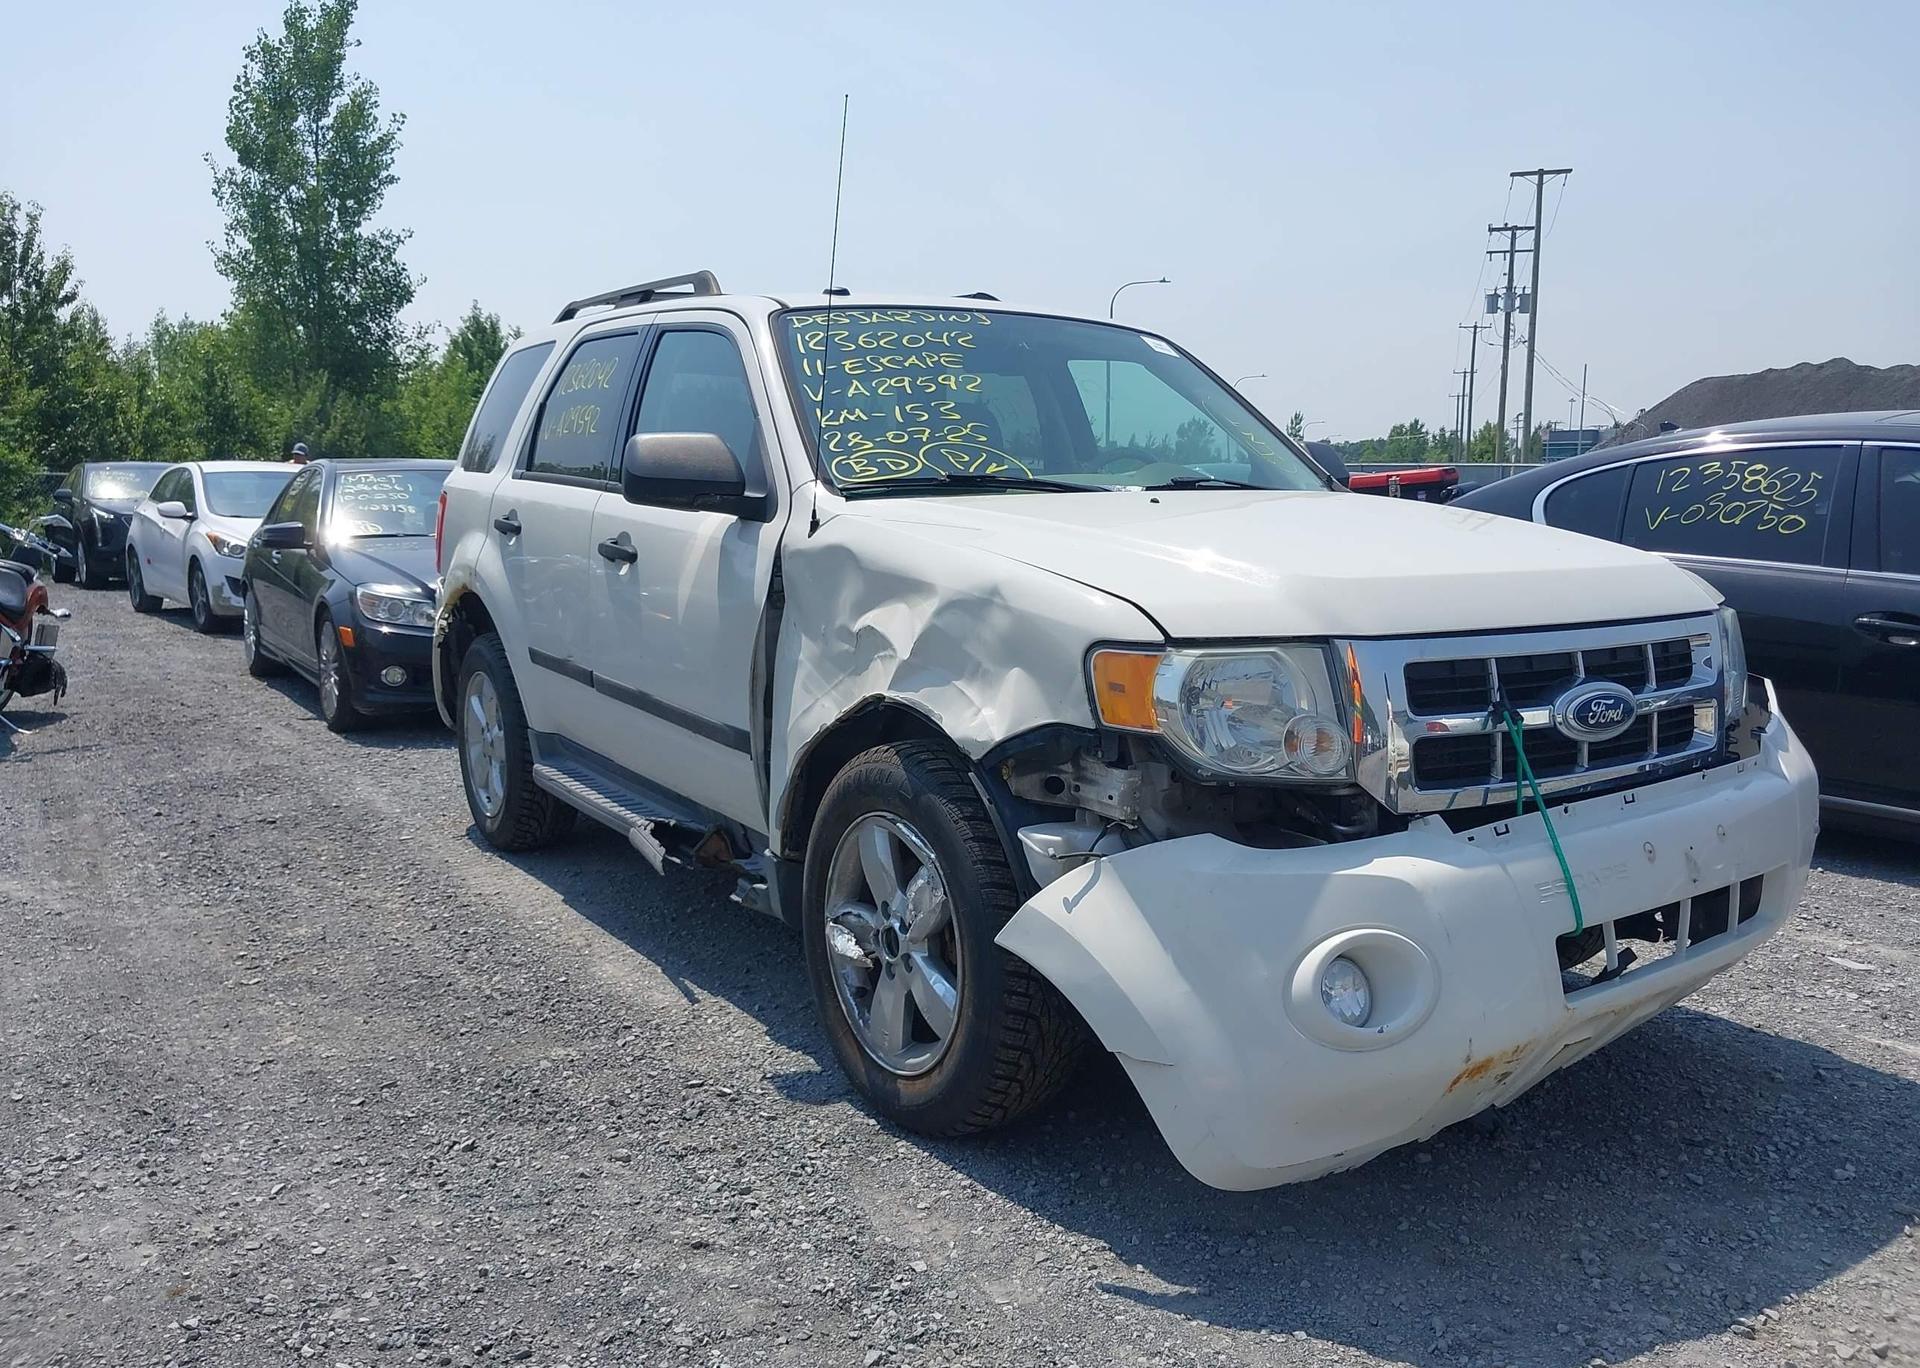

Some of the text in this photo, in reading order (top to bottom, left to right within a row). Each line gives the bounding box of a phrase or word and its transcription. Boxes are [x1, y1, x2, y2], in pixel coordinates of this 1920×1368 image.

[796, 331, 977, 354] 12362042
[803, 374, 983, 402] V-A29592
[1656, 460, 1823, 508] 12358625
[1645, 492, 1807, 534] V-030750
[1588, 699, 1624, 725] Ford
